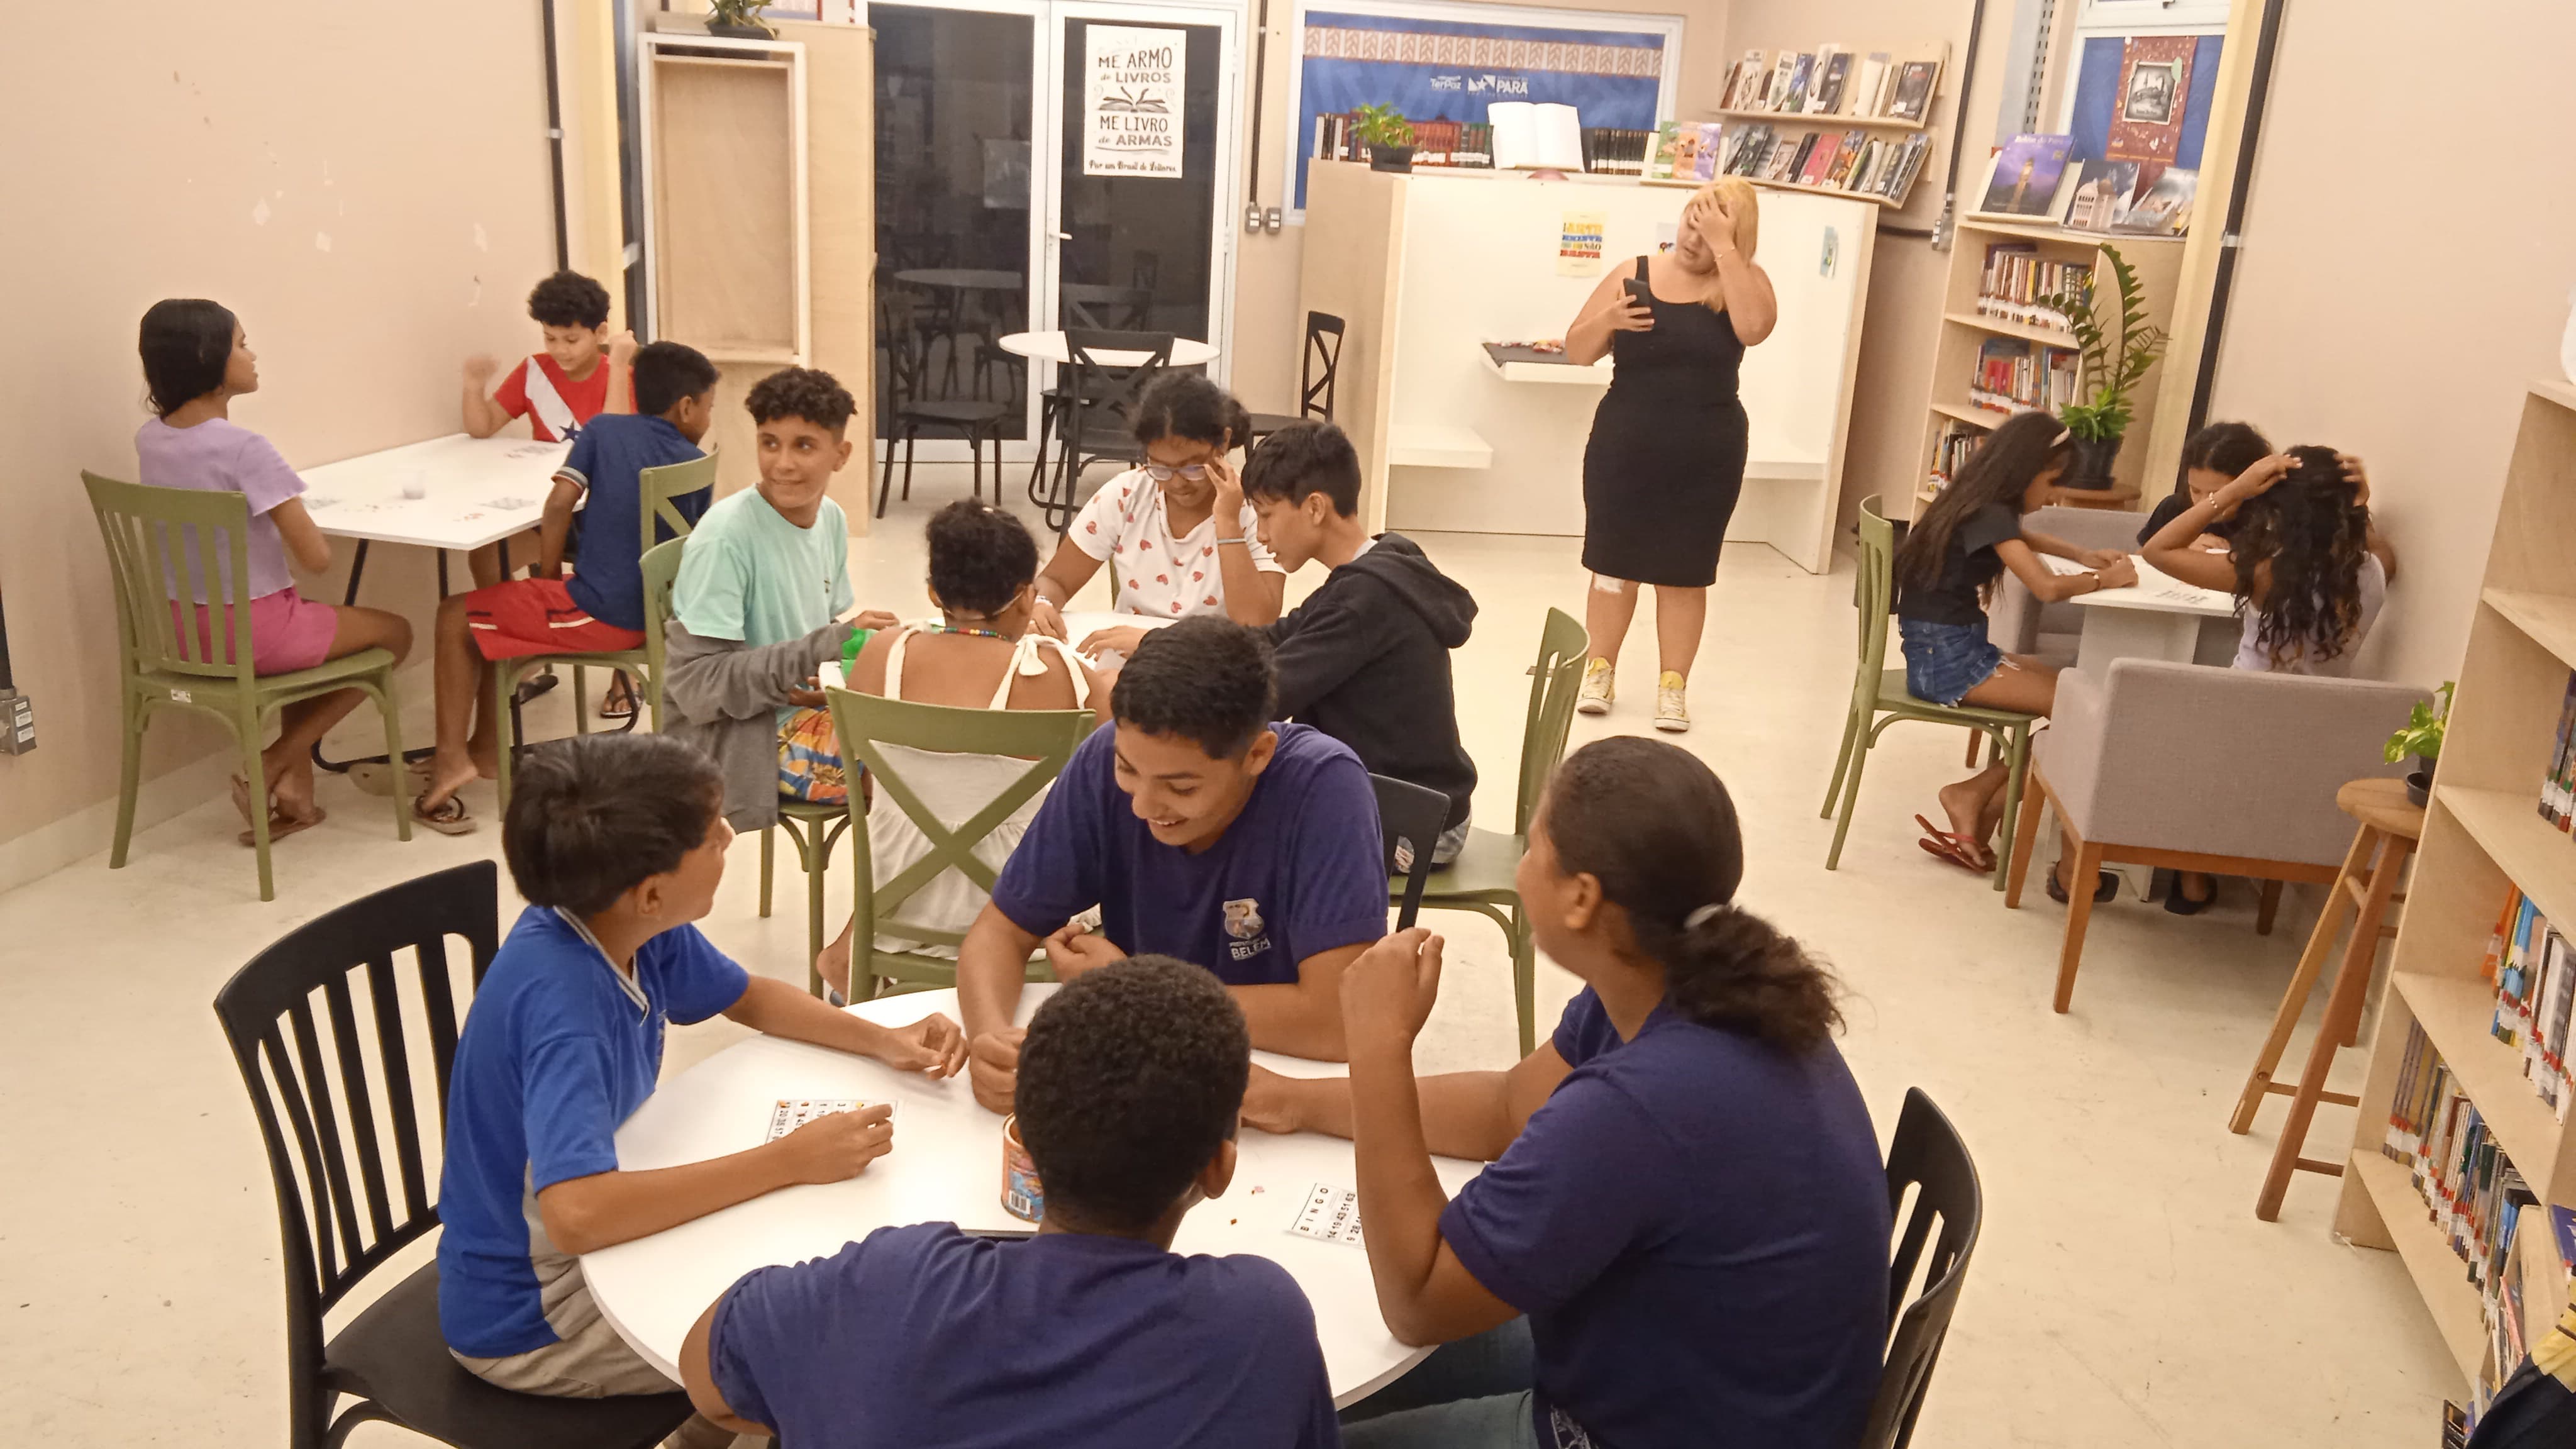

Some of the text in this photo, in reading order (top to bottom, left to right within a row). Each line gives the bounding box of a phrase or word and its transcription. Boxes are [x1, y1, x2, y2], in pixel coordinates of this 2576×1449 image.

[1099, 47, 1172, 69] ME ARMO
[1116, 72, 1172, 83] LIVROS
[1100, 115, 1169, 132] ME LIVRO
[1098, 134, 1173, 147] de ARMAS
